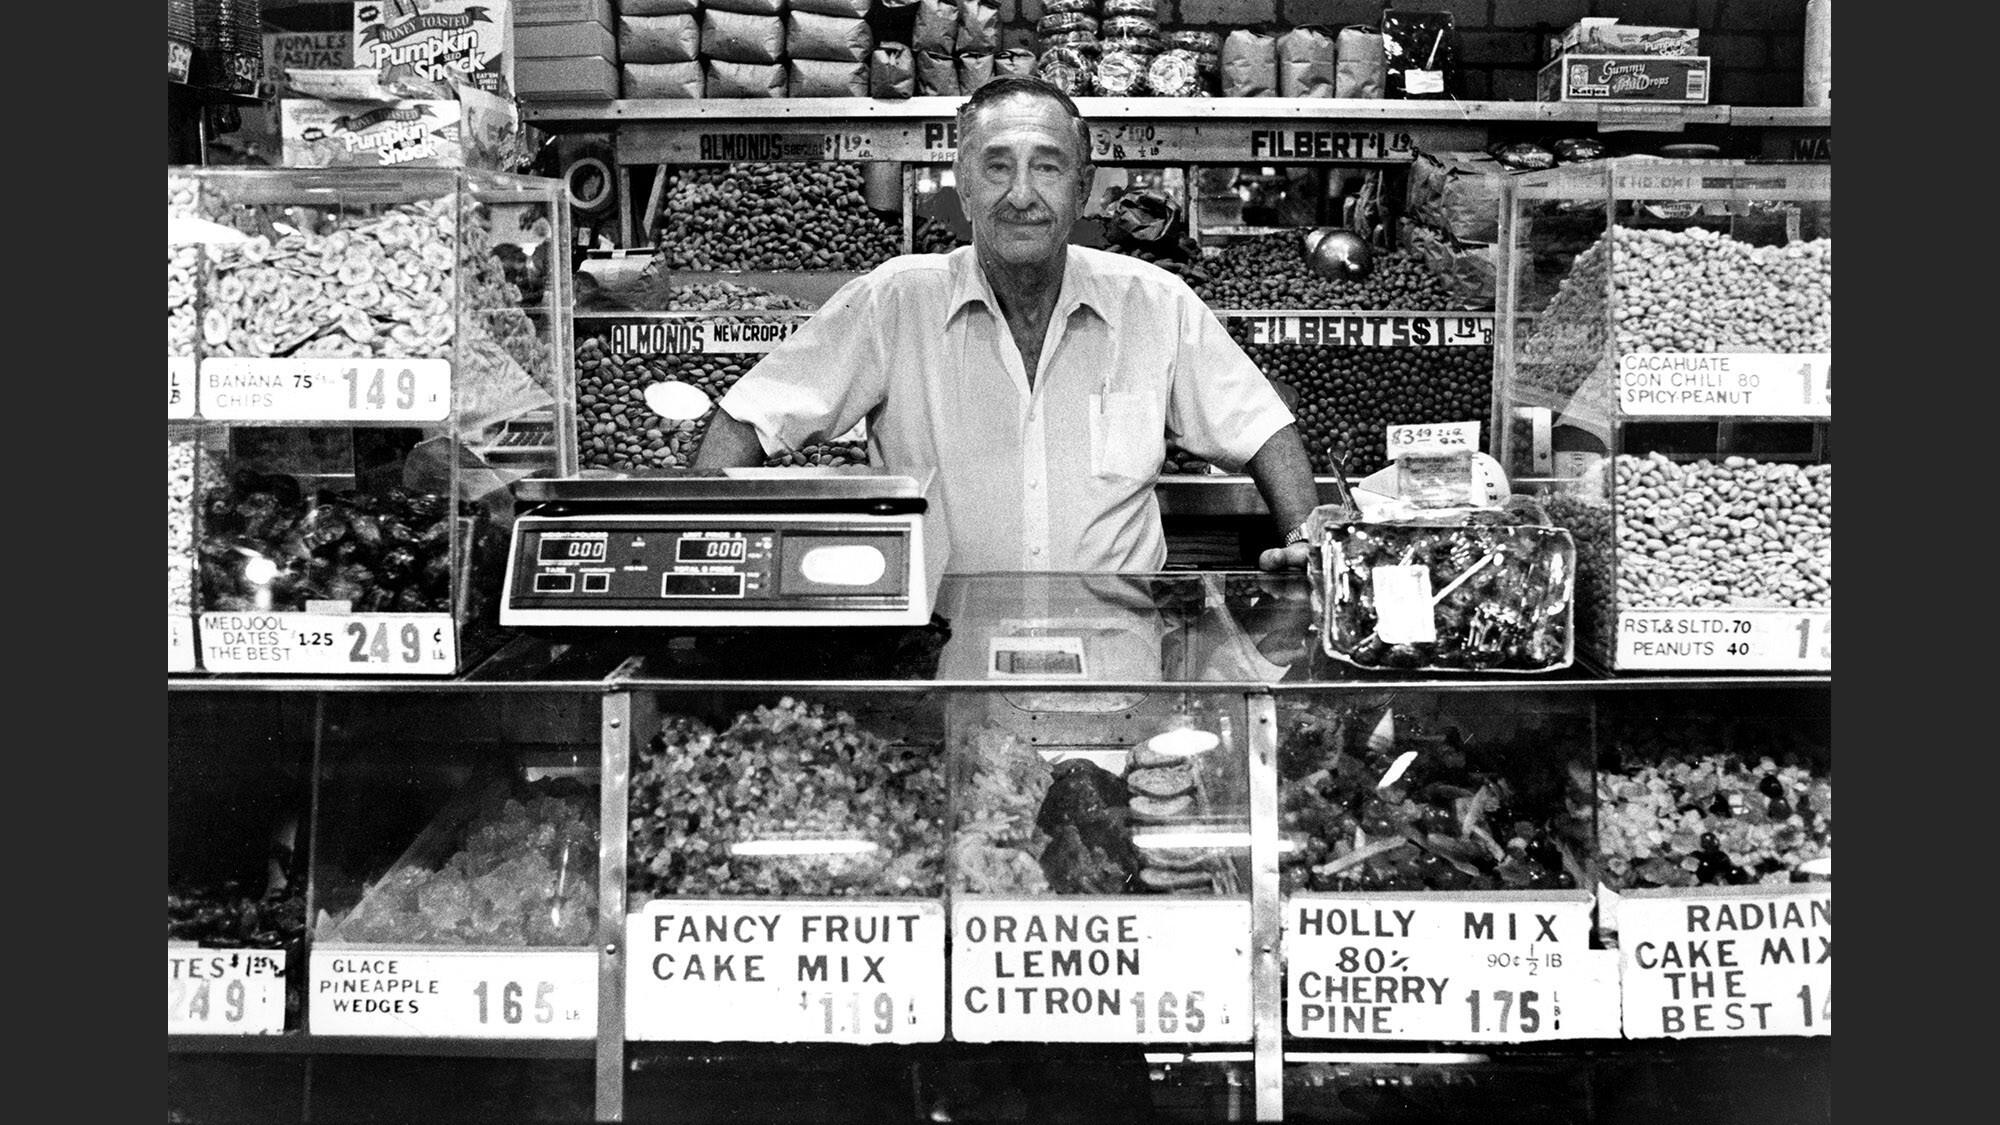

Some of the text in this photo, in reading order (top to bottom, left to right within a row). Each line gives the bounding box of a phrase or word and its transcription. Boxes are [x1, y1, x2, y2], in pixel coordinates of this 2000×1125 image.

[381, 14, 469, 42] HONEY TOASTED
[369, 27, 479, 69] Pumpkin
[1598, 60, 1646, 83] Gummy
[343, 120, 427, 151] Pumpkin
[701, 134, 782, 160] ALMONDS
[611, 324, 704, 354] ALMONDS
[714, 324, 742, 342] NEW
[1250, 317, 1411, 346] FILBERTS
[1624, 355, 1731, 372] CACAHUATE
[209, 374, 283, 388] BANANA
[293, 375, 313, 389] 75
[1624, 372, 1760, 388] CON CHILI 80
[216, 393, 273, 408] CHIPS
[205, 616, 288, 631] MEDJOOL
[223, 631, 280, 646] DATES
[1633, 641, 1750, 656] PEANUTS 40
[209, 646, 291, 662] THE BEST
[654, 914, 921, 944] FANCY FRUIT
[965, 914, 1140, 944] ORANGE
[1299, 908, 1560, 942] HOLLY MIX
[1687, 899, 1831, 933] RADIAN
[332, 960, 399, 975] GLACE
[995, 948, 1140, 978] LEMON
[1335, 946, 1410, 975] 80%
[1635, 936, 1831, 970] CAKE MIX
[169, 957, 225, 979] TES
[652, 952, 886, 984] CAKE MIX
[319, 979, 440, 995] PINEAPPLE
[1298, 971, 1449, 1005] CHERRY
[1663, 970, 1747, 1000] THE
[333, 999, 420, 1015] WEDGES
[472, 981, 555, 1025] 165
[964, 986, 1121, 1016] CITRON
[1130, 990, 1206, 1034] 165
[1661, 1002, 1773, 1034] BEST
